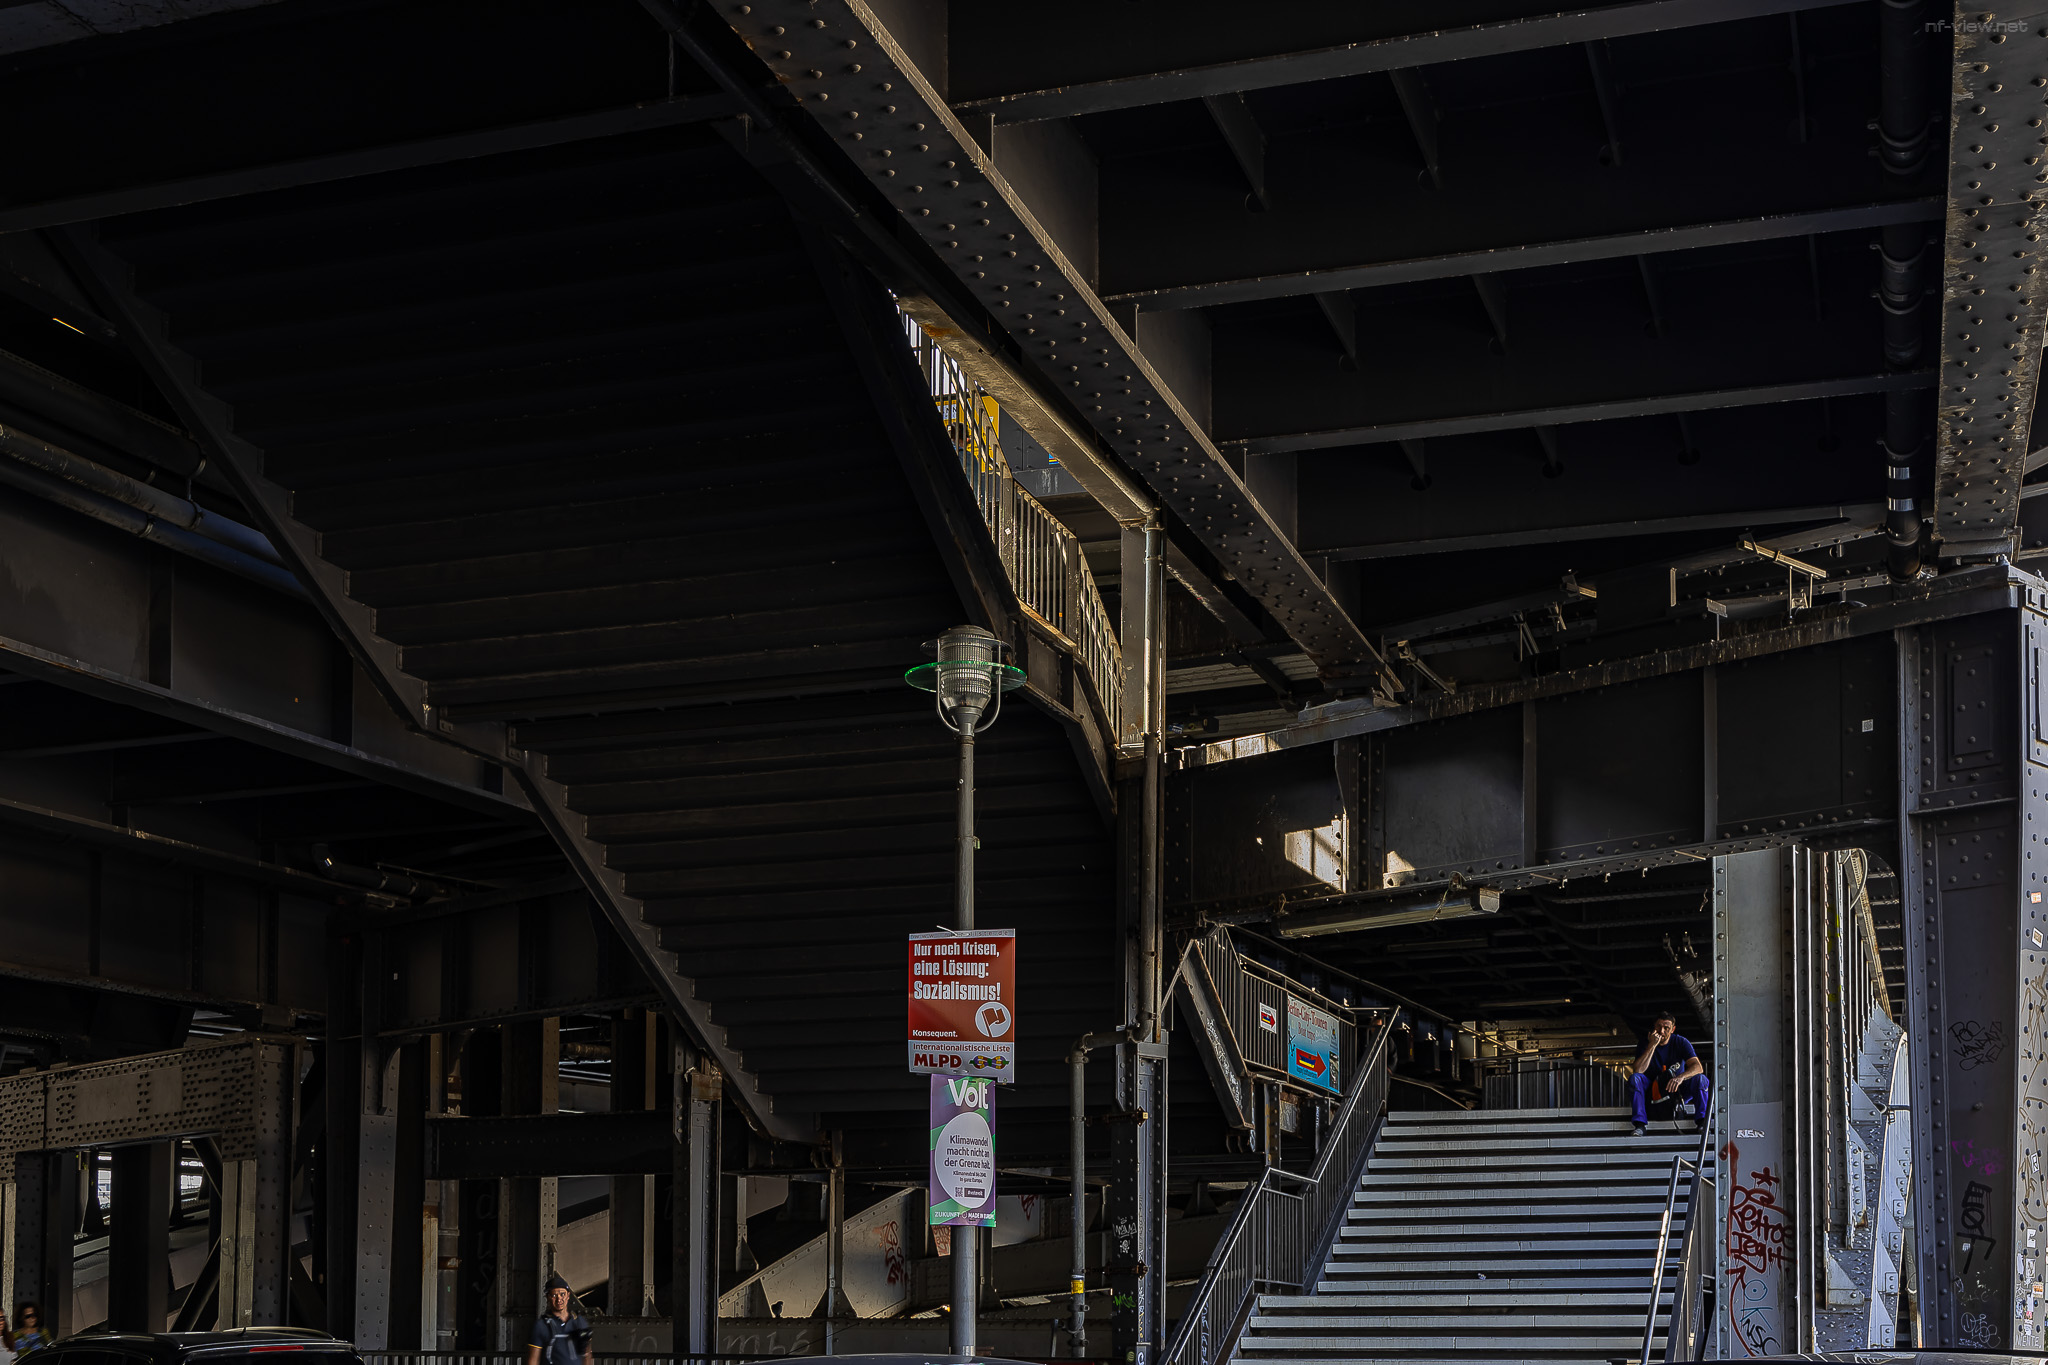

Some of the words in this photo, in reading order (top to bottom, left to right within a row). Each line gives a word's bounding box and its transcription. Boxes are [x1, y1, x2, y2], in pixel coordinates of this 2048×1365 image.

[914, 943, 932, 957] Nur
[934, 942, 960, 956] noch
[962, 941, 1000, 957] Krisen,
[914, 960, 940, 976] eine
[943, 959, 989, 979] Lösung:
[913, 980, 1001, 1001] Sozialismus!
[912, 1029, 958, 1039] Konsequent.
[913, 1042, 991, 1053] Internationalistische
[992, 1044, 1011, 1053] Liste
[914, 1053, 962, 1068] MLPD
[947, 1078, 989, 1110] Volt
[949, 1134, 989, 1147] Klimawandel
[946, 1147, 970, 1157] macht
[970, 1147, 984, 1158] nicht
[984, 1150, 990, 1158] an
[944, 1157, 958, 1167] der
[959, 1158, 980, 1169] Grenze
[934, 1211, 960, 1219] ZUKUNFT
